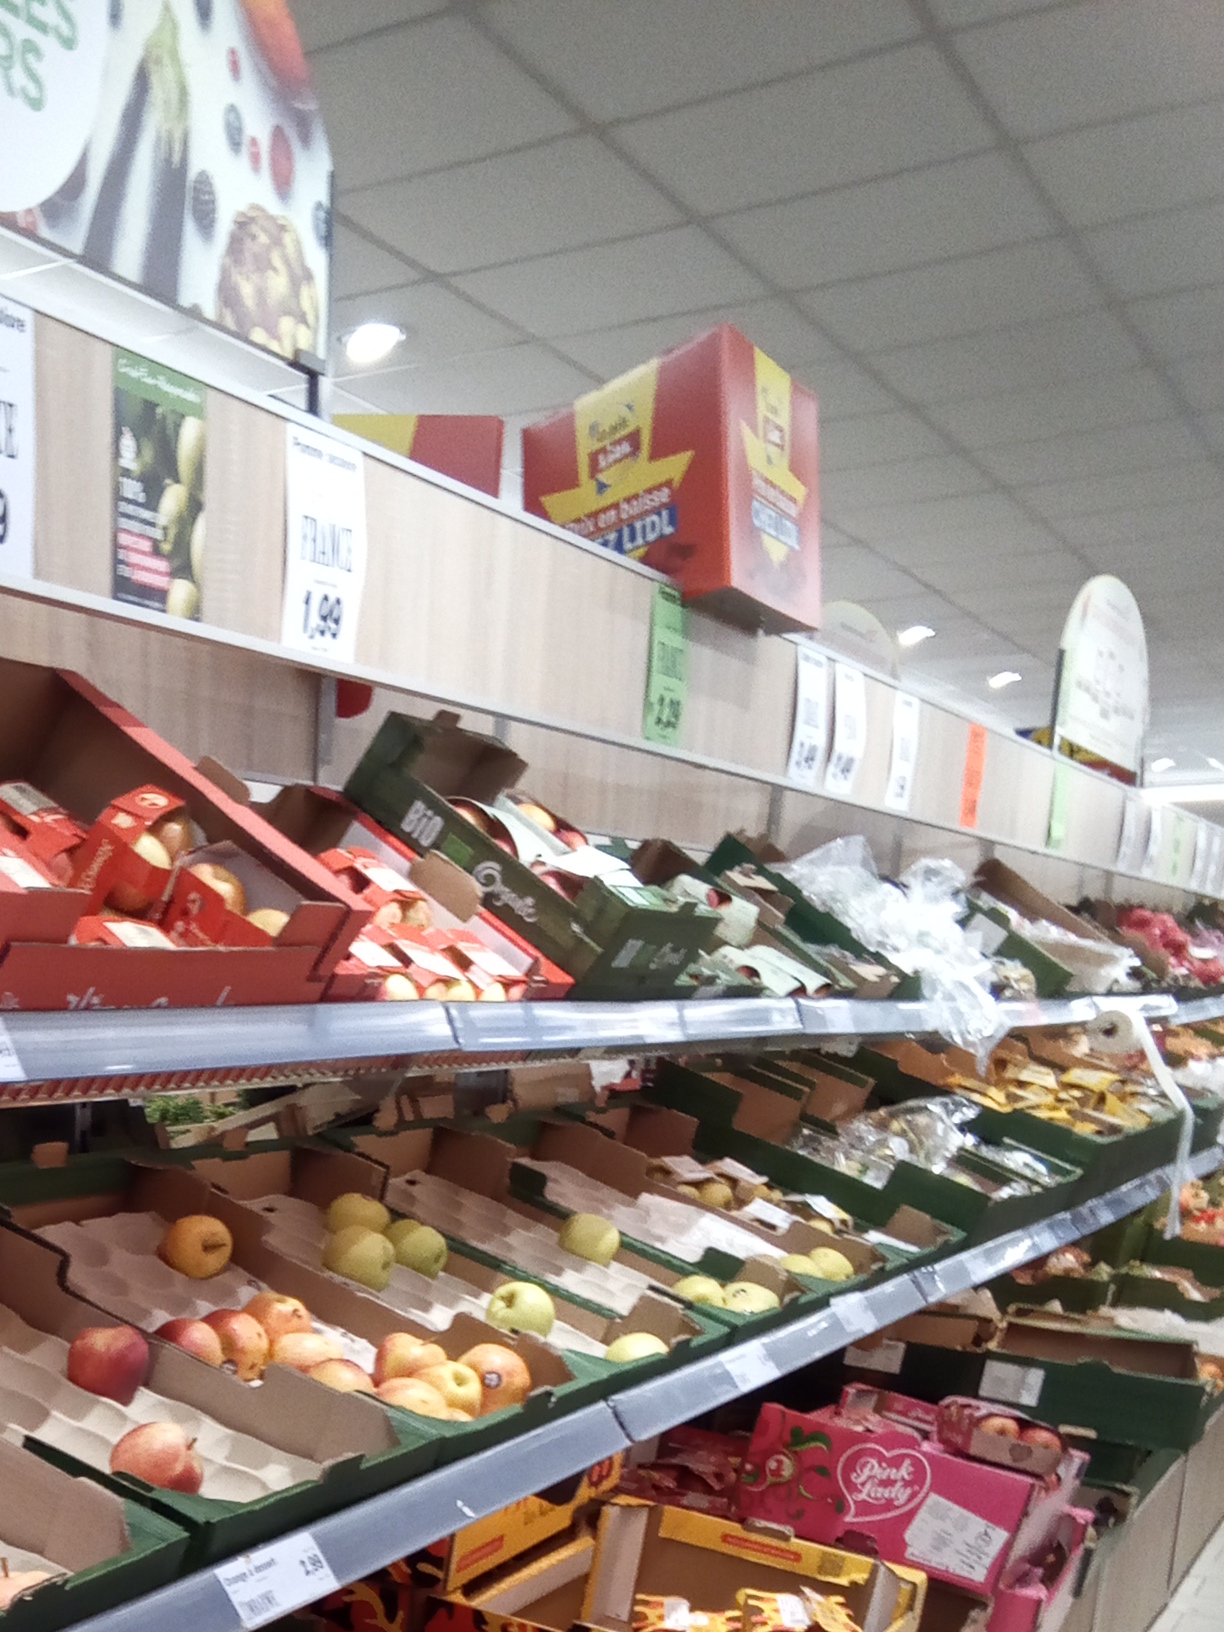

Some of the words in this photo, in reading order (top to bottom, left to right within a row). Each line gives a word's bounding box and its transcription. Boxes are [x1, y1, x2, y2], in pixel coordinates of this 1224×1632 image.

[301, 514, 353, 573] FRANCE
[303, 590, 343, 640] 1,99
[851, 1457, 915, 1483] Pink
[852, 1479, 913, 1507] Lady
